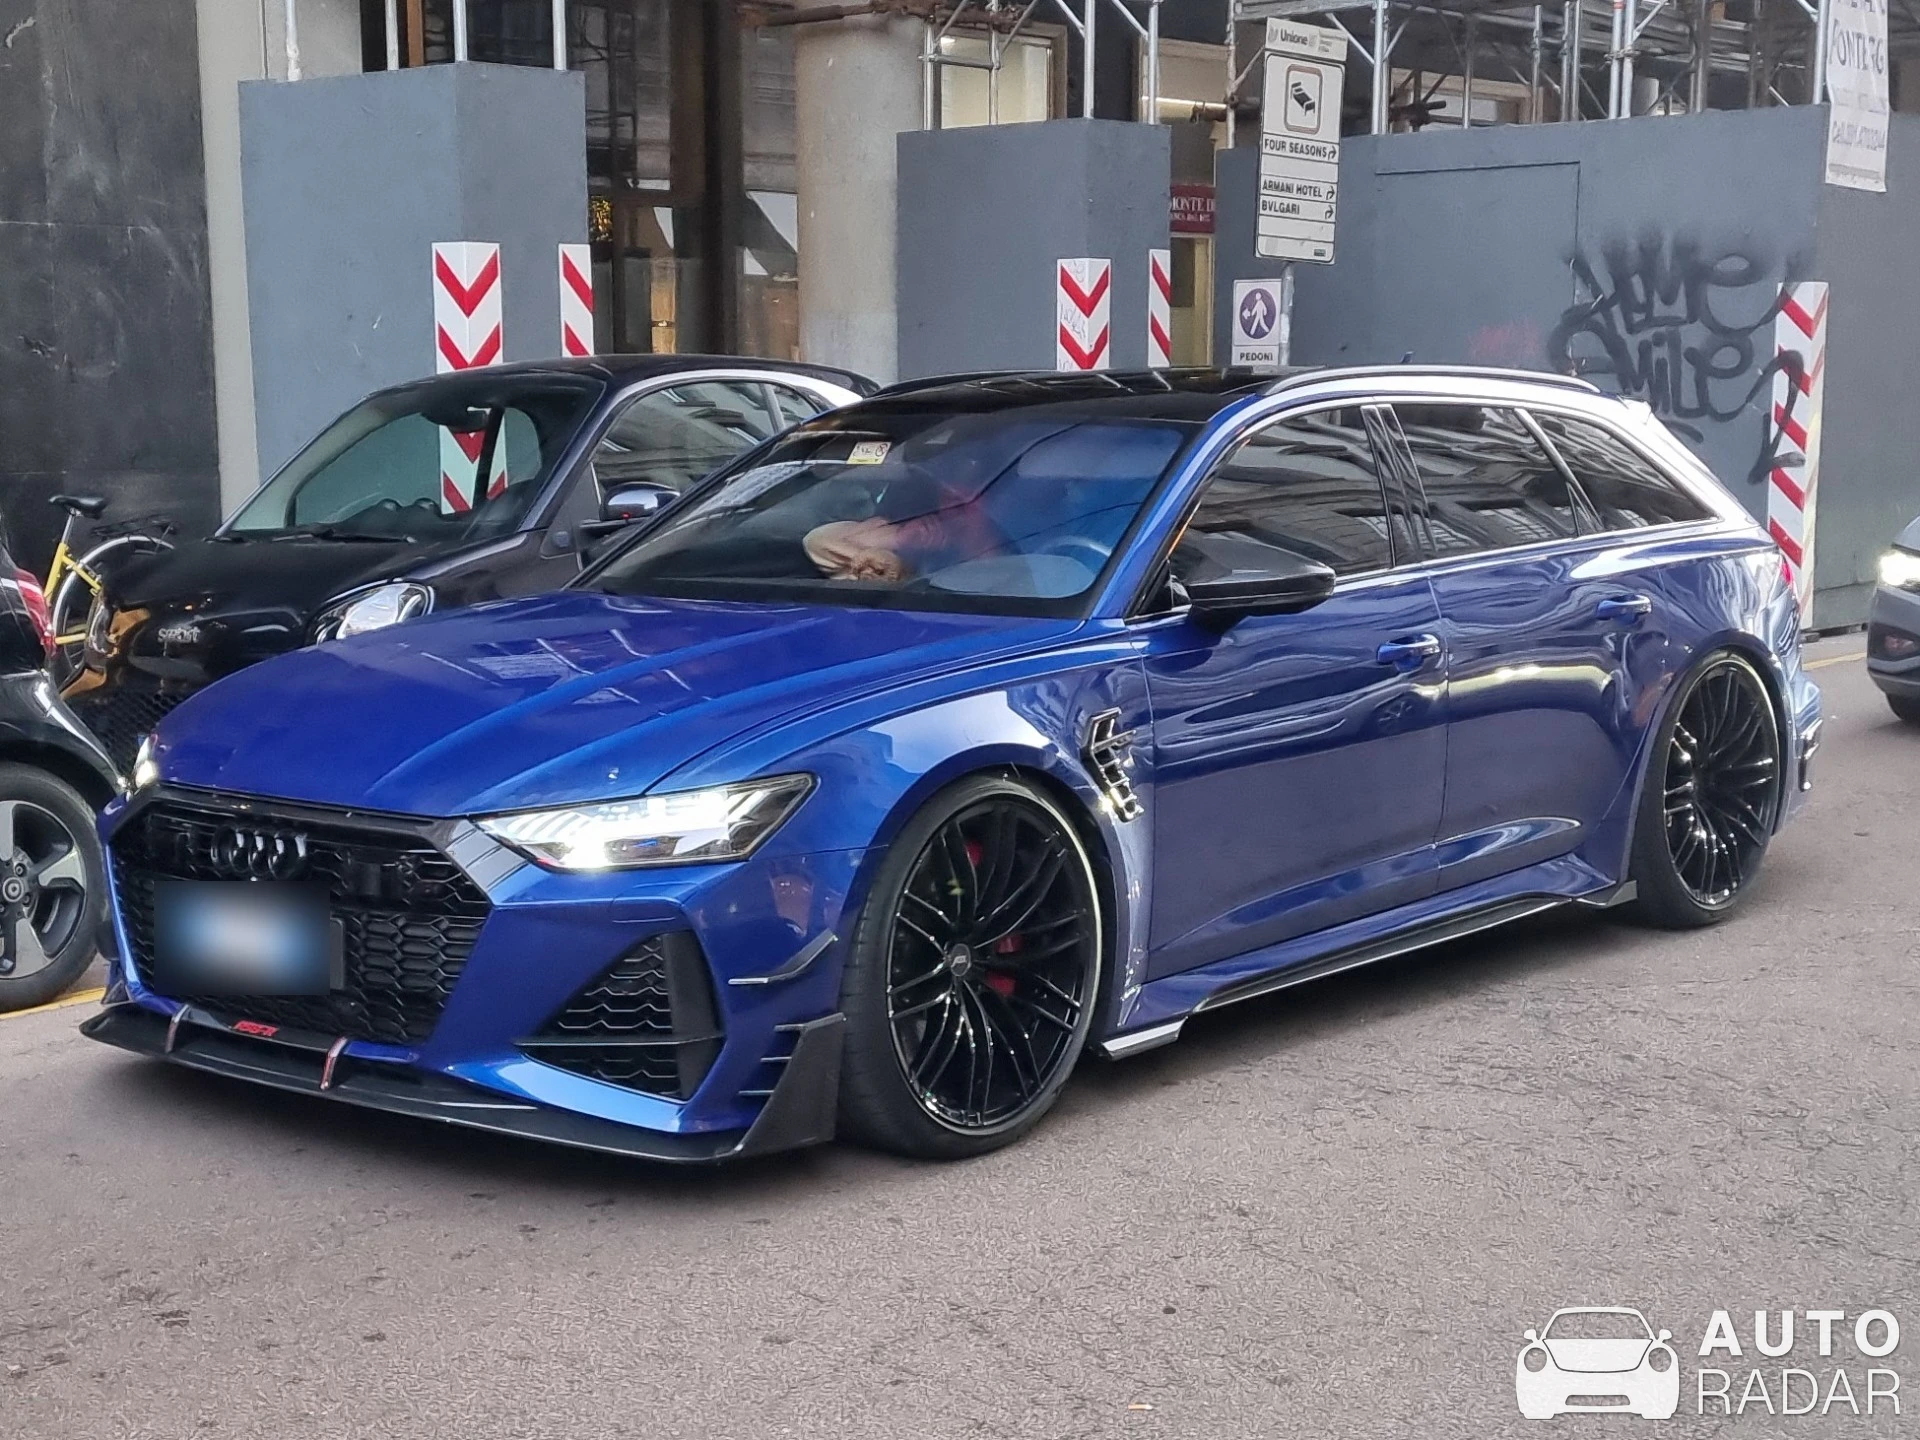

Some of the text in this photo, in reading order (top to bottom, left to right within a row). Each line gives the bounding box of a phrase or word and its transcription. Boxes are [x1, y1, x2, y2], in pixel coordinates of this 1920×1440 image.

[1280, 28, 1308, 46] Unione
[1264, 138, 1327, 158] FOUR SEASONS
[1262, 179, 1322, 198] ARMANI HOTEL
[1261, 199, 1300, 215] BVLGARI
[1240, 352, 1273, 361] PEDONI
